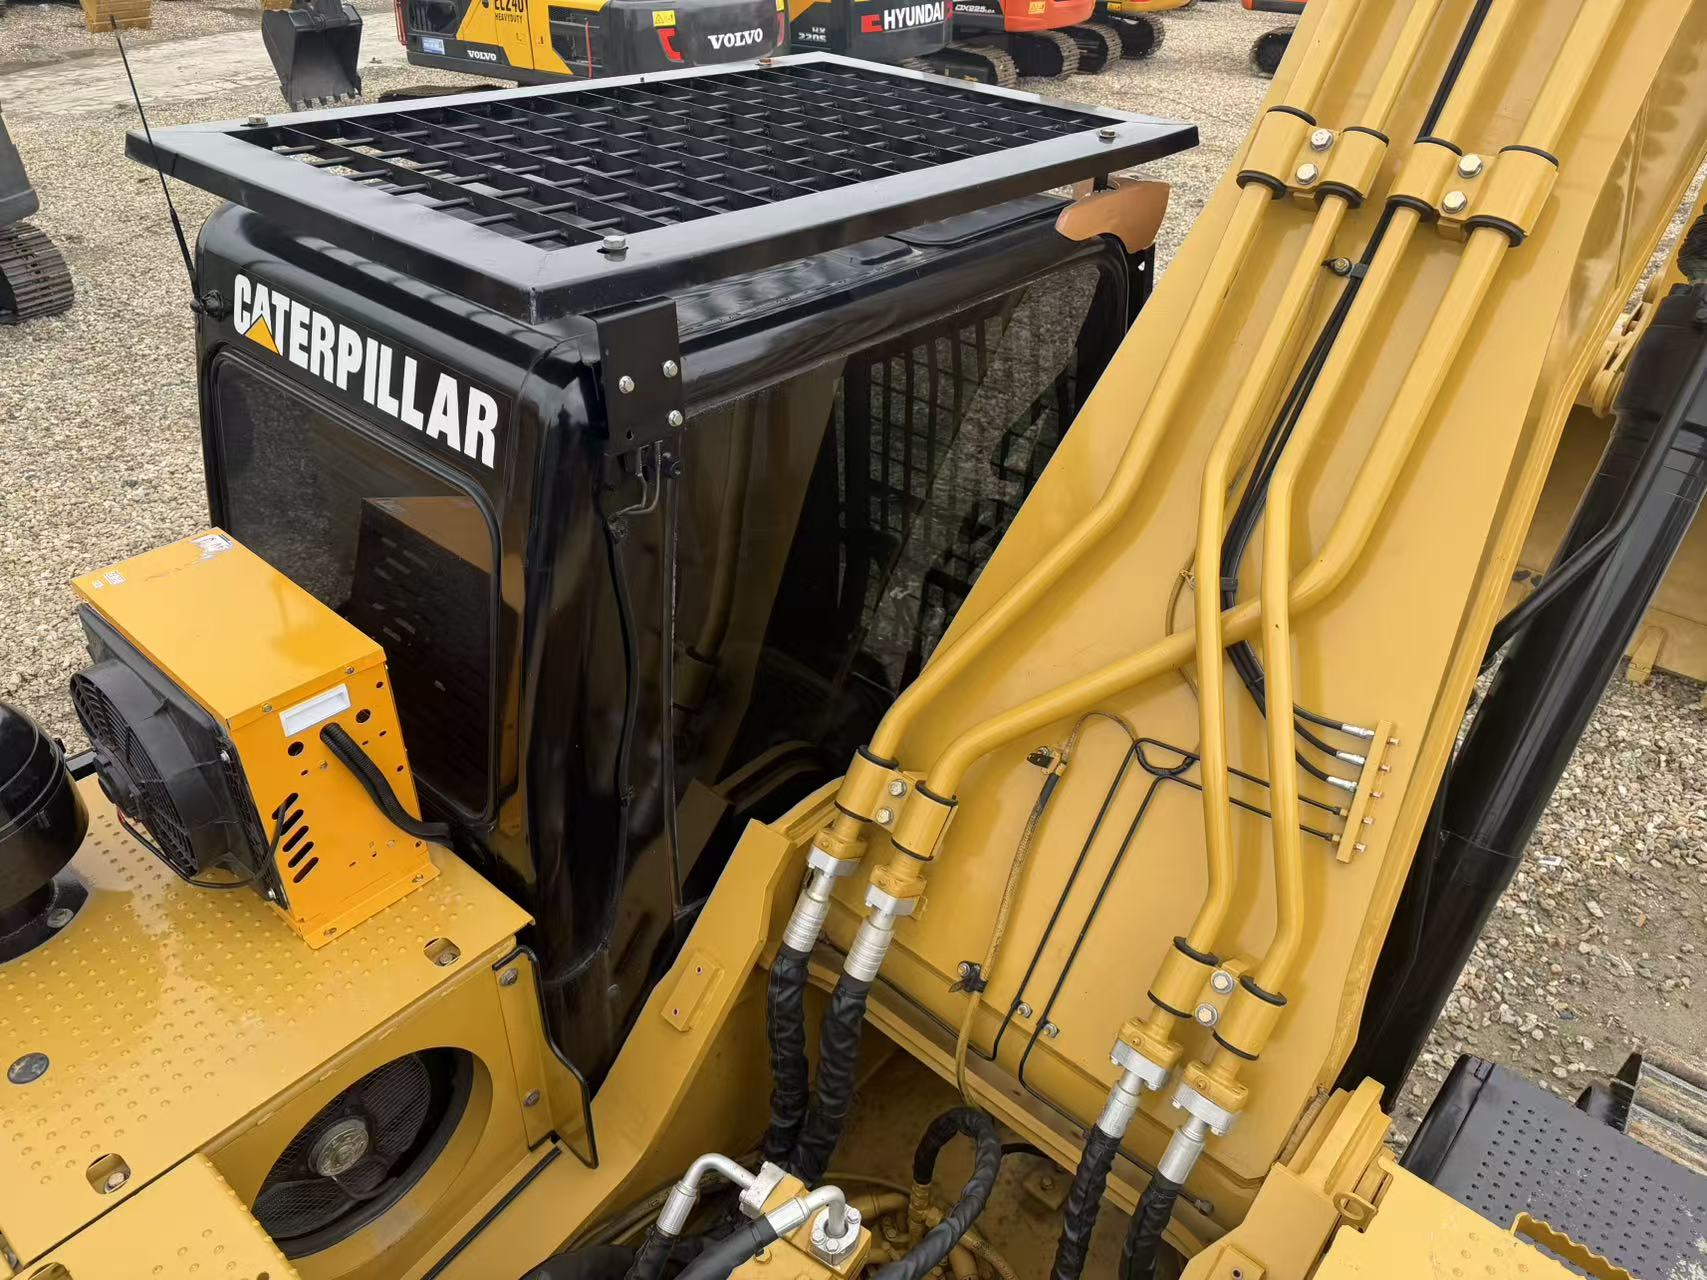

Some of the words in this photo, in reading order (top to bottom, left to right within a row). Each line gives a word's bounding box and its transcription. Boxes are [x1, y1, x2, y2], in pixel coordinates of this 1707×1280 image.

[884, 2, 944, 30] HYUNDAI
[707, 28, 763, 49] VOLVO
[467, 50, 497, 61] VOLVO
[233, 273, 498, 469] CATERPILLAR
